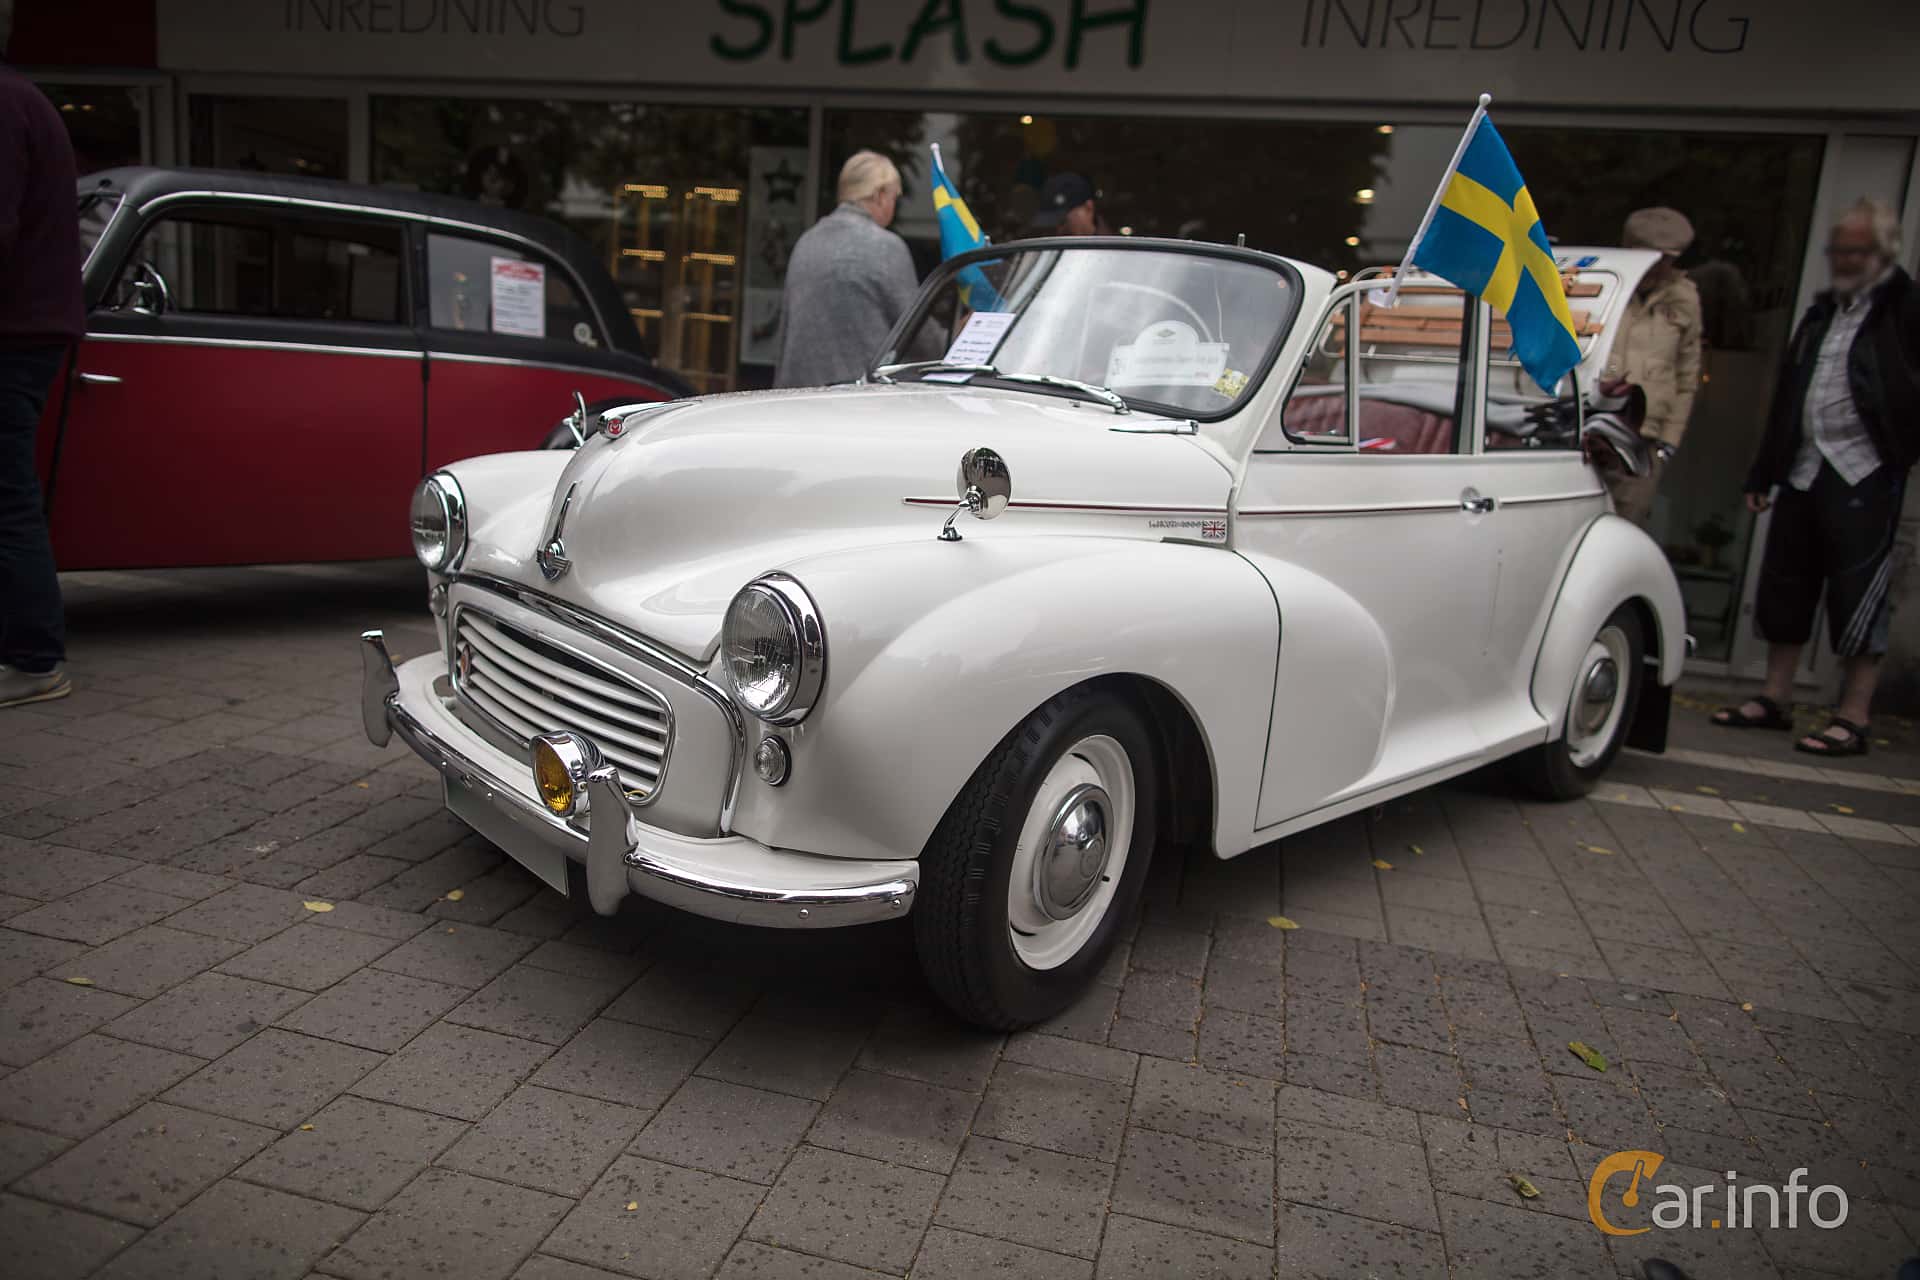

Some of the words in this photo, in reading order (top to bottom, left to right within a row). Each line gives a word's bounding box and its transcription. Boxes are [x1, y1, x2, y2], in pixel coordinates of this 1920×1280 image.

[285, 0, 585, 36] INREDNING
[710, 0, 1148, 70] SPLASH
[1301, 0, 1750, 53] INREDNING
